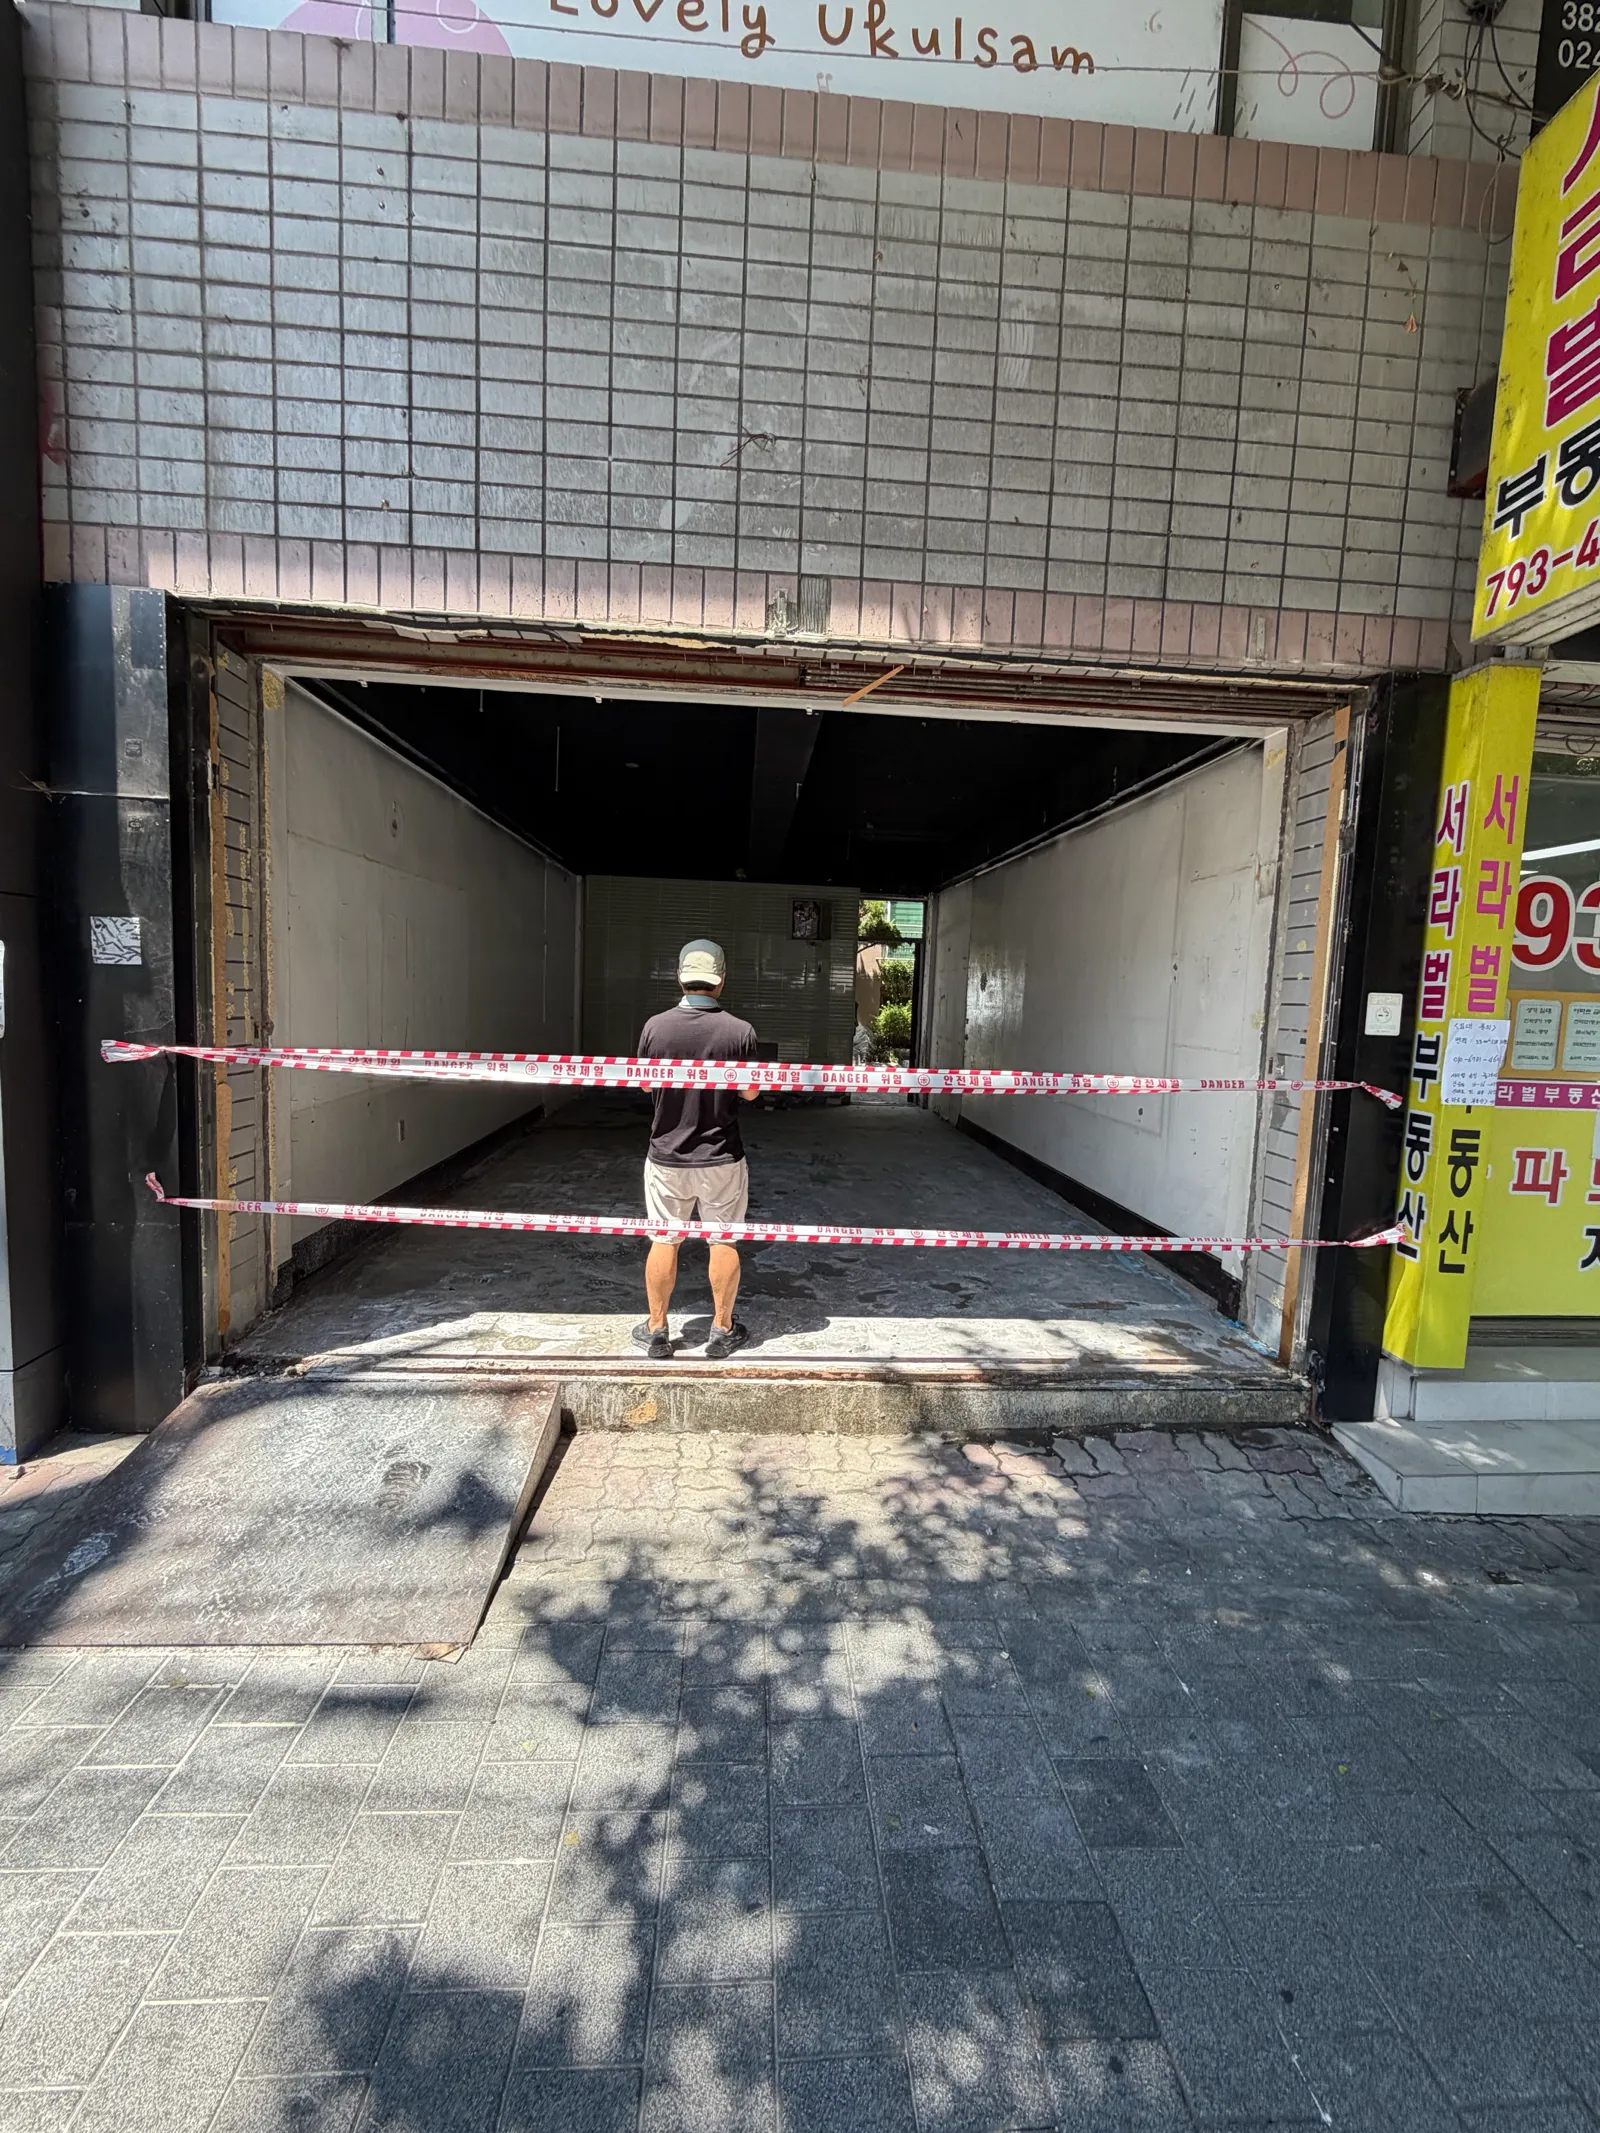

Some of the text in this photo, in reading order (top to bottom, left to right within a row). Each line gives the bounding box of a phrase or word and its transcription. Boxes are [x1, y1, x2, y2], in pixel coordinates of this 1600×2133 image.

[818, 0, 1094, 74] Ukulsam
[1486, 519, 1600, 618] 793-4
[552, 1063, 604, 1077] 안전제일
[626, 1067, 674, 1079] DANGER
[686, 1068, 708, 1080] 위험
[750, 1069, 801, 1083] 안전제일
[822, 1072, 869, 1084] DANGER
[881, 1073, 902, 1085] 위험
[943, 1075, 992, 1087] 안전제일
[1013, 1077, 1059, 1087] DANGER
[1070, 1077, 1092, 1088] 위험
[1200, 1079, 1245, 1089] DANGER
[1256, 1079, 1277, 1090] 위험
[817, 1225, 862, 1235] DANGER
